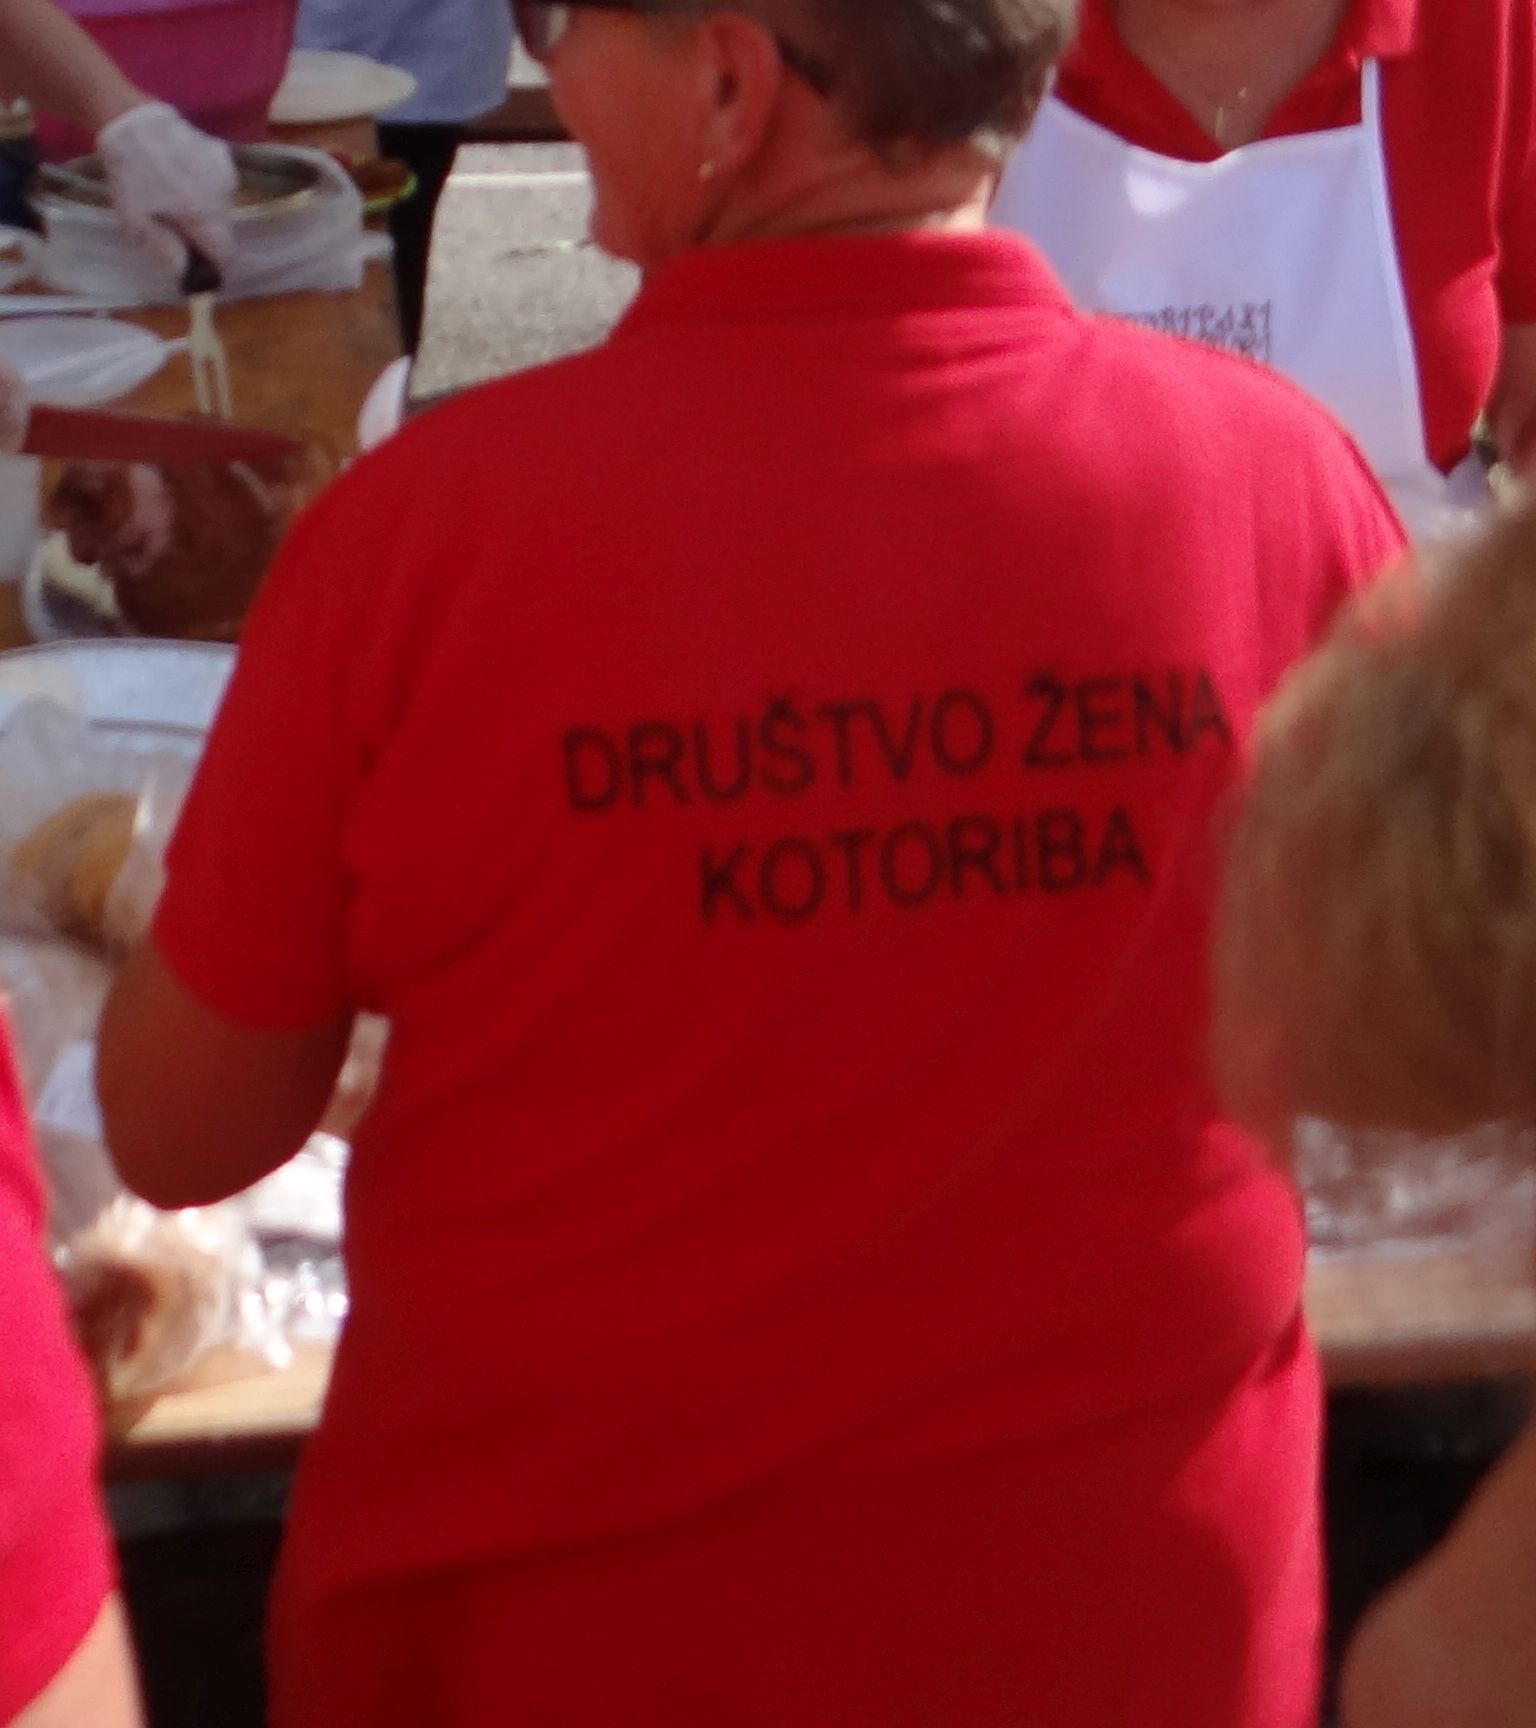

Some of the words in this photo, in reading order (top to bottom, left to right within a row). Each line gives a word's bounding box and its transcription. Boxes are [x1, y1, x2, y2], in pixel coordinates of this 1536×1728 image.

[563, 690, 996, 815] DRUŠTVO
[1022, 664, 1233, 772] ŽENA
[699, 805, 1152, 926] KOTORIBA
